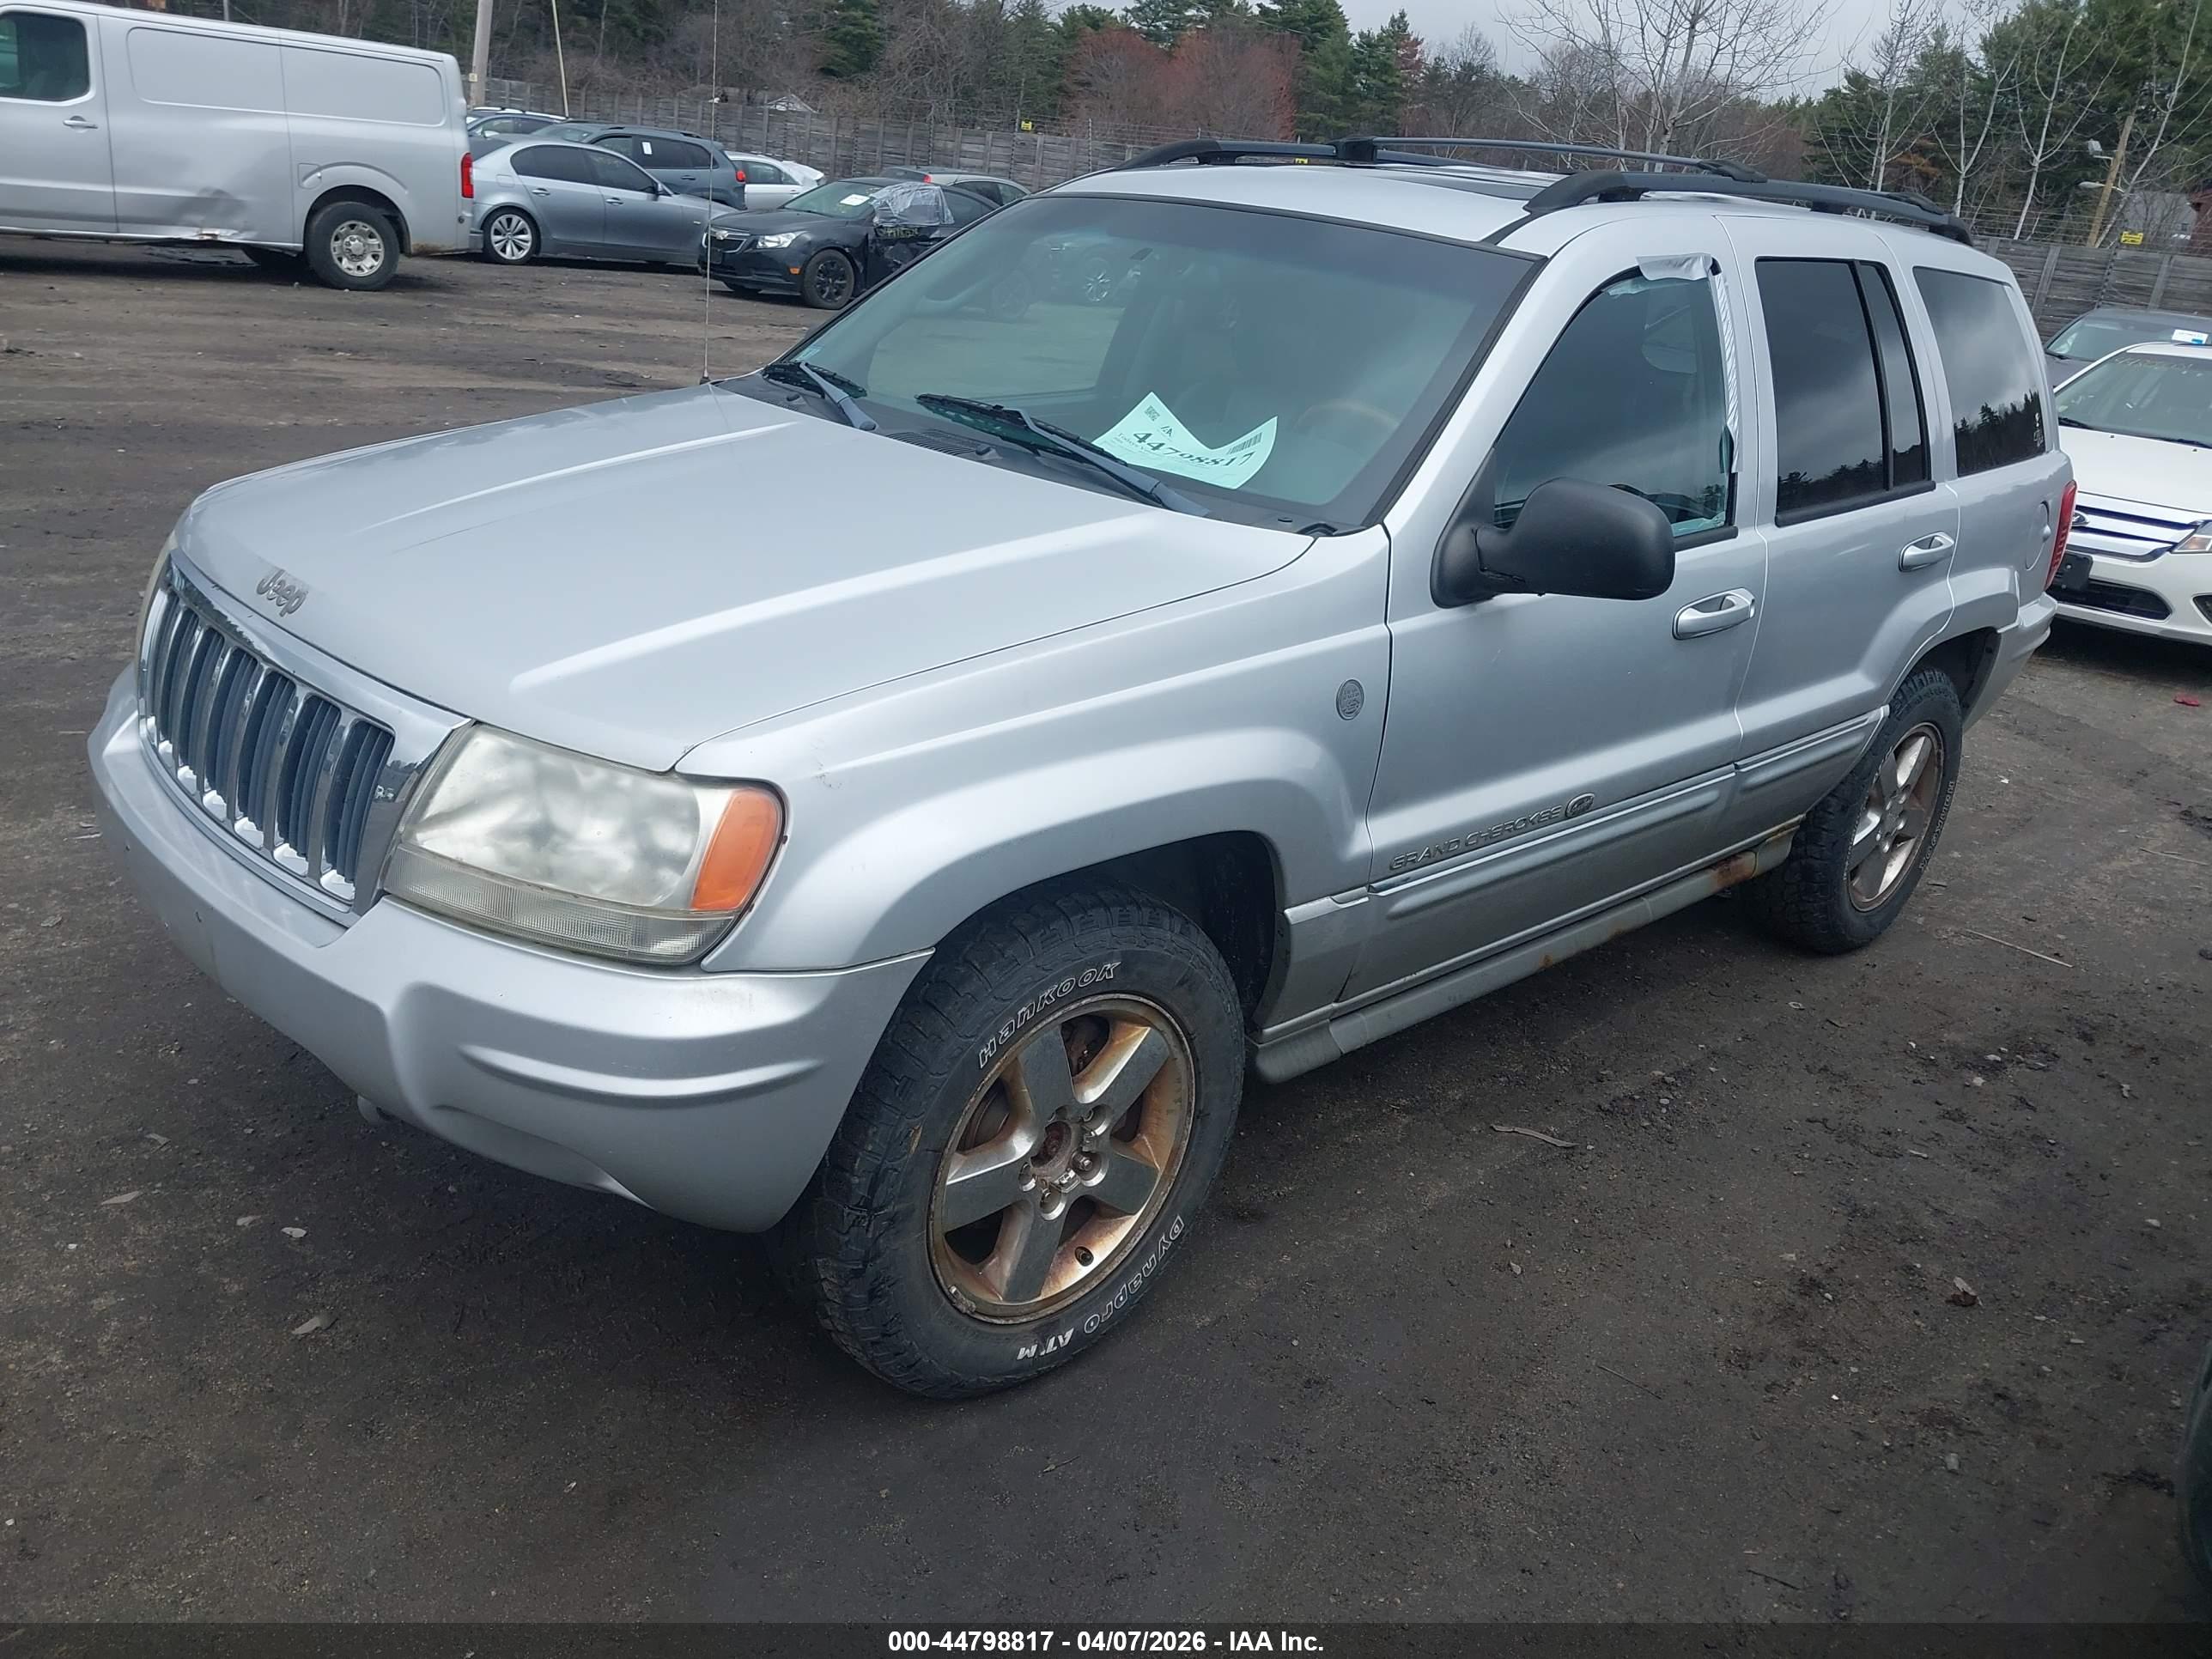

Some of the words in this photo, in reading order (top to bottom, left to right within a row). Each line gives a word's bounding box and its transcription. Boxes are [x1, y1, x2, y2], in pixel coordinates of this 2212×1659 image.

[257, 568, 308, 617] Jeep
[1389, 835, 1460, 871] GRAND
[1464, 805, 1563, 847] CHEROKEE
